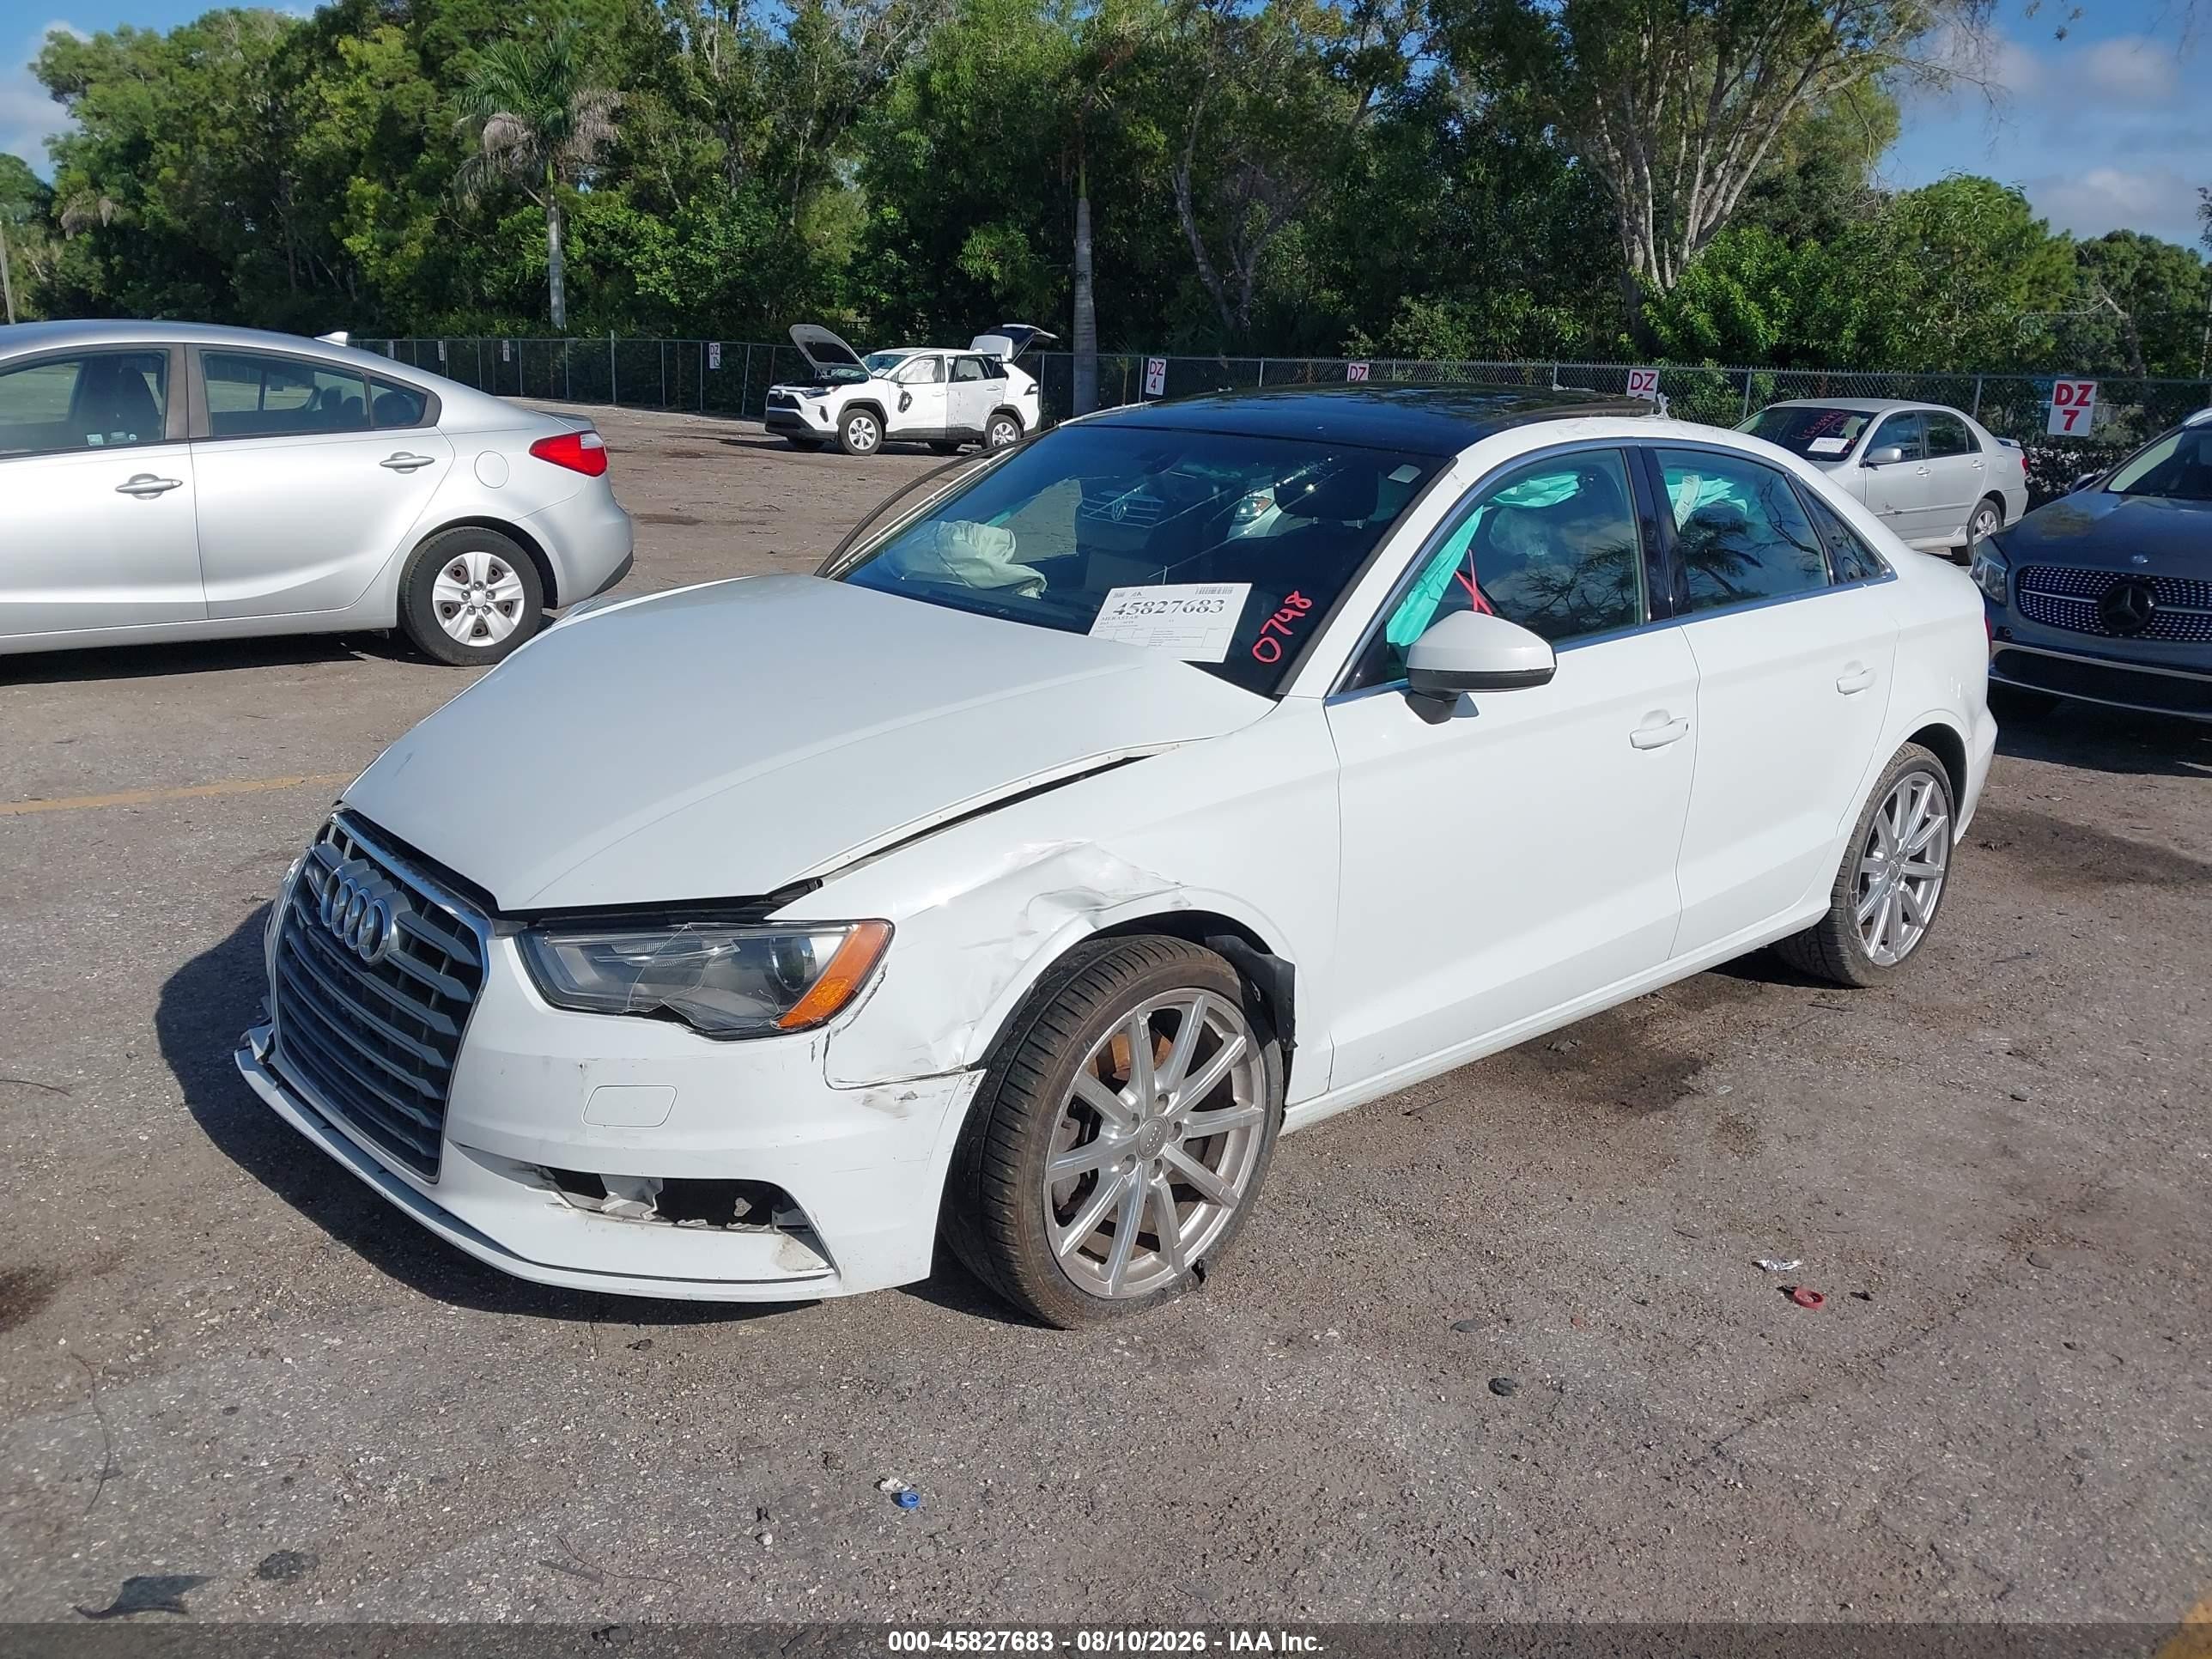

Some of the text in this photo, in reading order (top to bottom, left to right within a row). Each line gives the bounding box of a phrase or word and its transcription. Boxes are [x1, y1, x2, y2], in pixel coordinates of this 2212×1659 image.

[1149, 361, 1164, 376] DZ
[1151, 377, 1157, 391] 4
[1630, 372, 1656, 391] DZ
[2054, 383, 2094, 406] DZ
[2063, 409, 2080, 431] 7
[1113, 599, 1224, 616] 45827683
